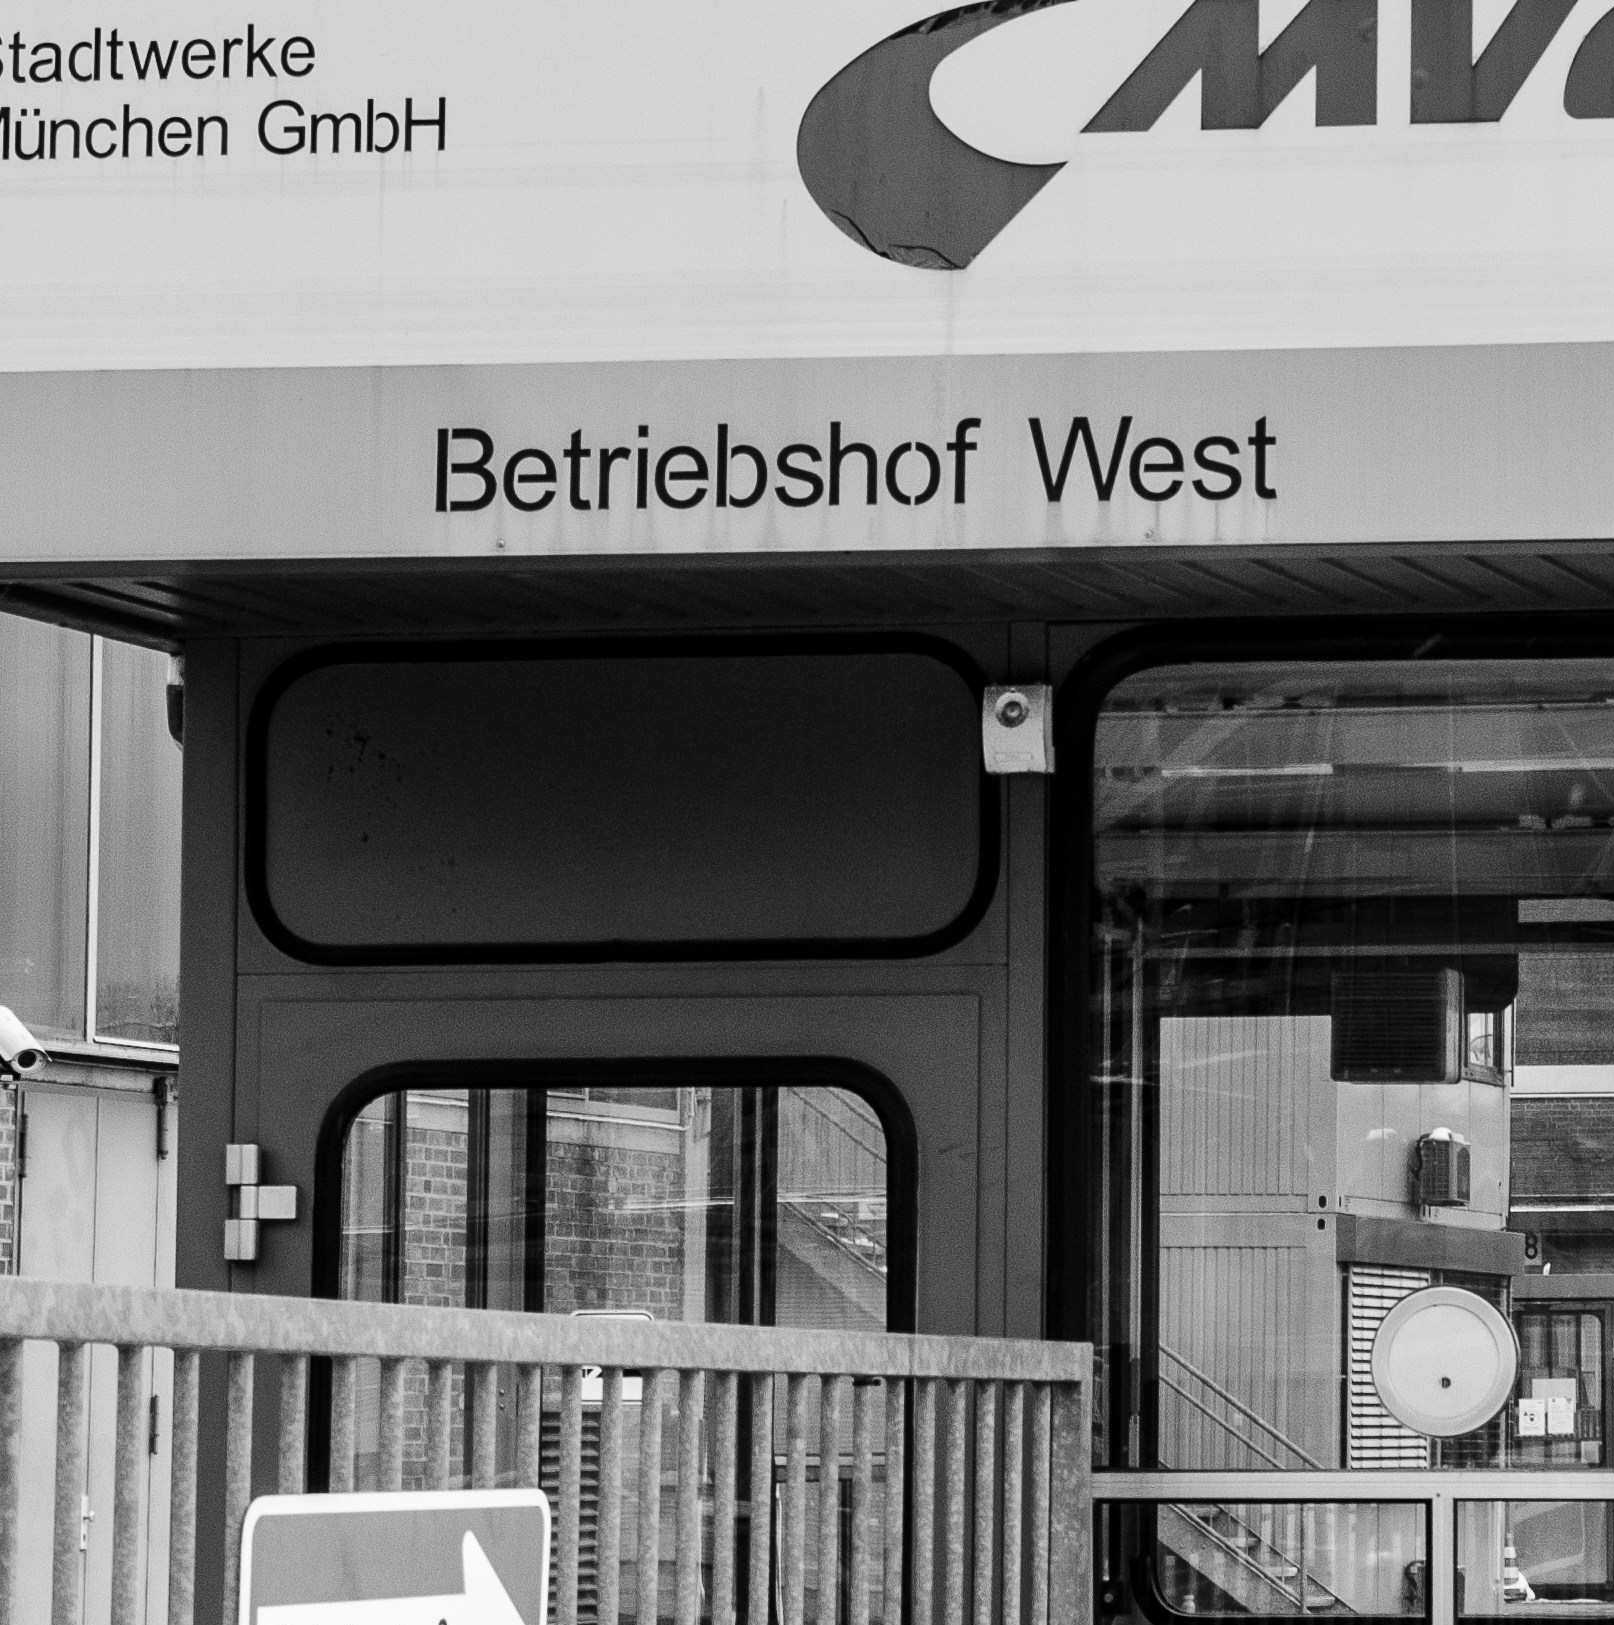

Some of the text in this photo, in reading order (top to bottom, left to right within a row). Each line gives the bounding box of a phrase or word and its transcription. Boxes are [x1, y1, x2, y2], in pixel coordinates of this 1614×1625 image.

[0, 26, 315, 83] tadtwerke
[258, 97, 446, 155] GmbH
[436, 416, 1276, 512] Betriebshof West
